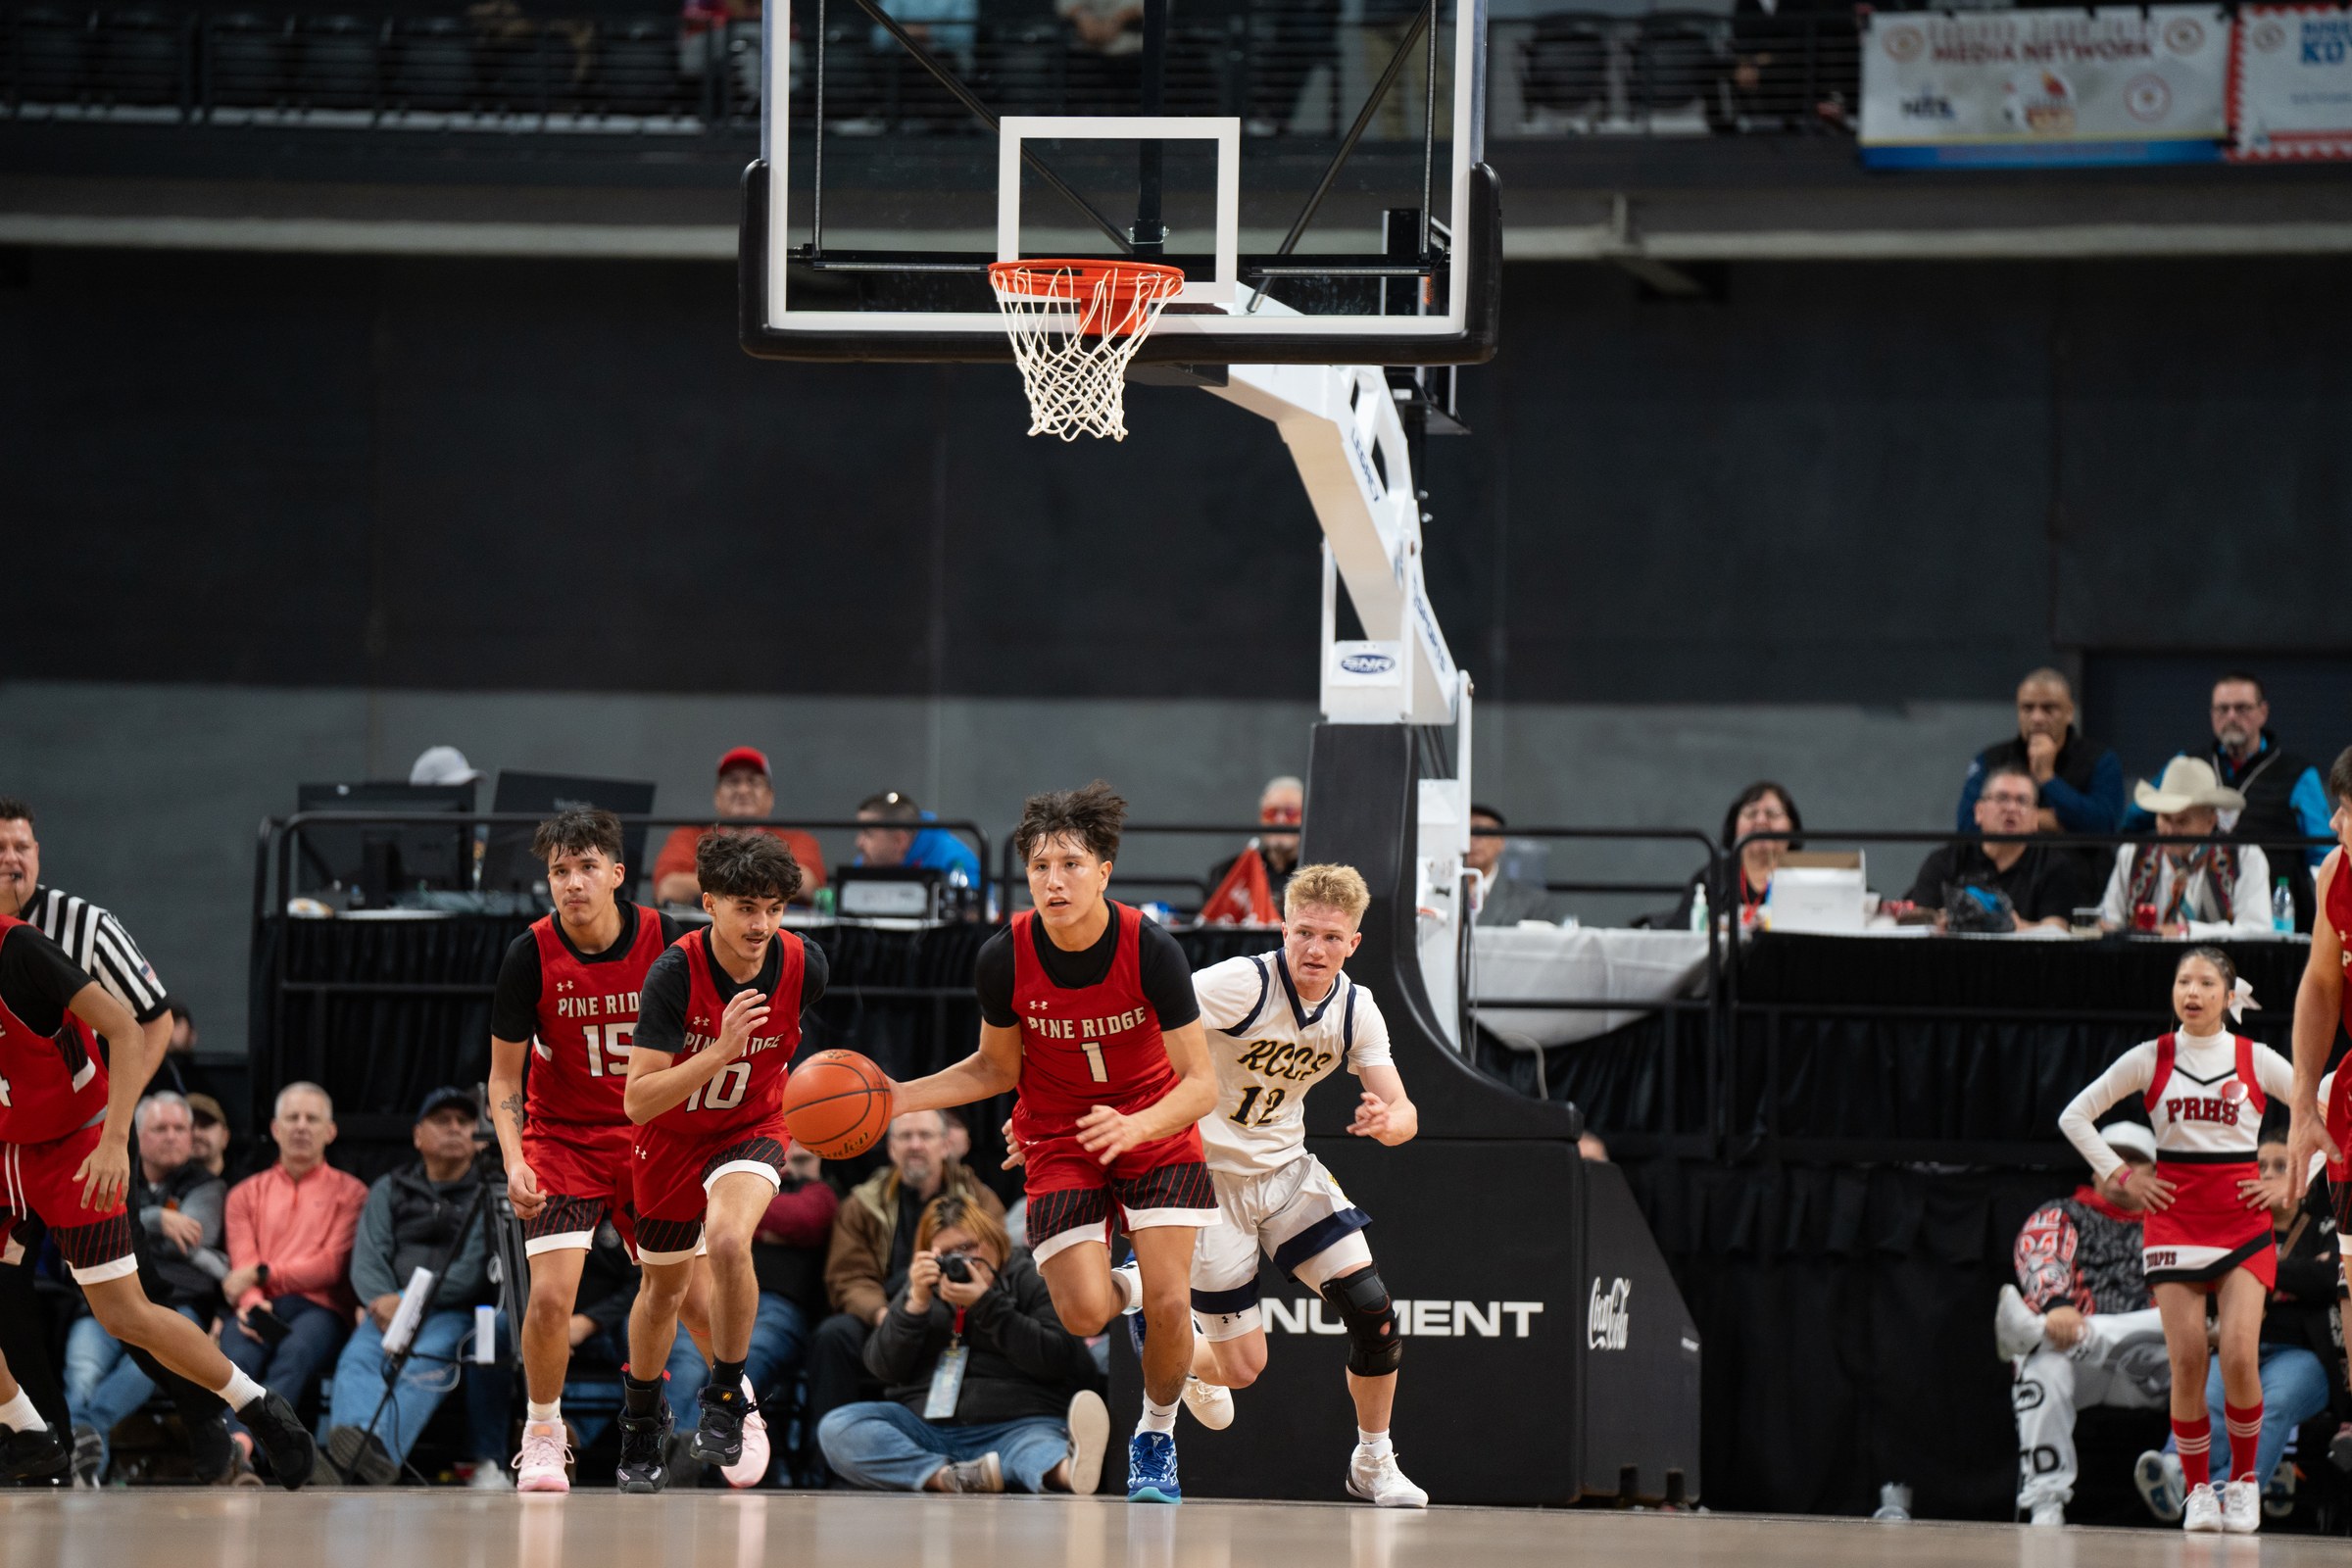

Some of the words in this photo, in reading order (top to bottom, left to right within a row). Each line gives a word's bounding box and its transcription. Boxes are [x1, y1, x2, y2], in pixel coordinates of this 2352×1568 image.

[1932, 42, 2017, 62] MEDIA
[2022, 37, 2152, 60] NETWORK
[558, 996, 600, 1018] PINE
[605, 990, 643, 1015] RID
[1027, 1016, 1076, 1039] PINE
[1081, 1005, 1147, 1038] RIDGE
[582, 1021, 637, 1077] 15
[683, 1031, 717, 1054] PIN
[741, 1033, 785, 1057] IDGE
[1237, 1040, 1332, 1081] RCCS
[1081, 1041, 1108, 1083] 1
[1229, 1085, 1286, 1126] 12
[2167, 1097, 2240, 1127] PRHS
